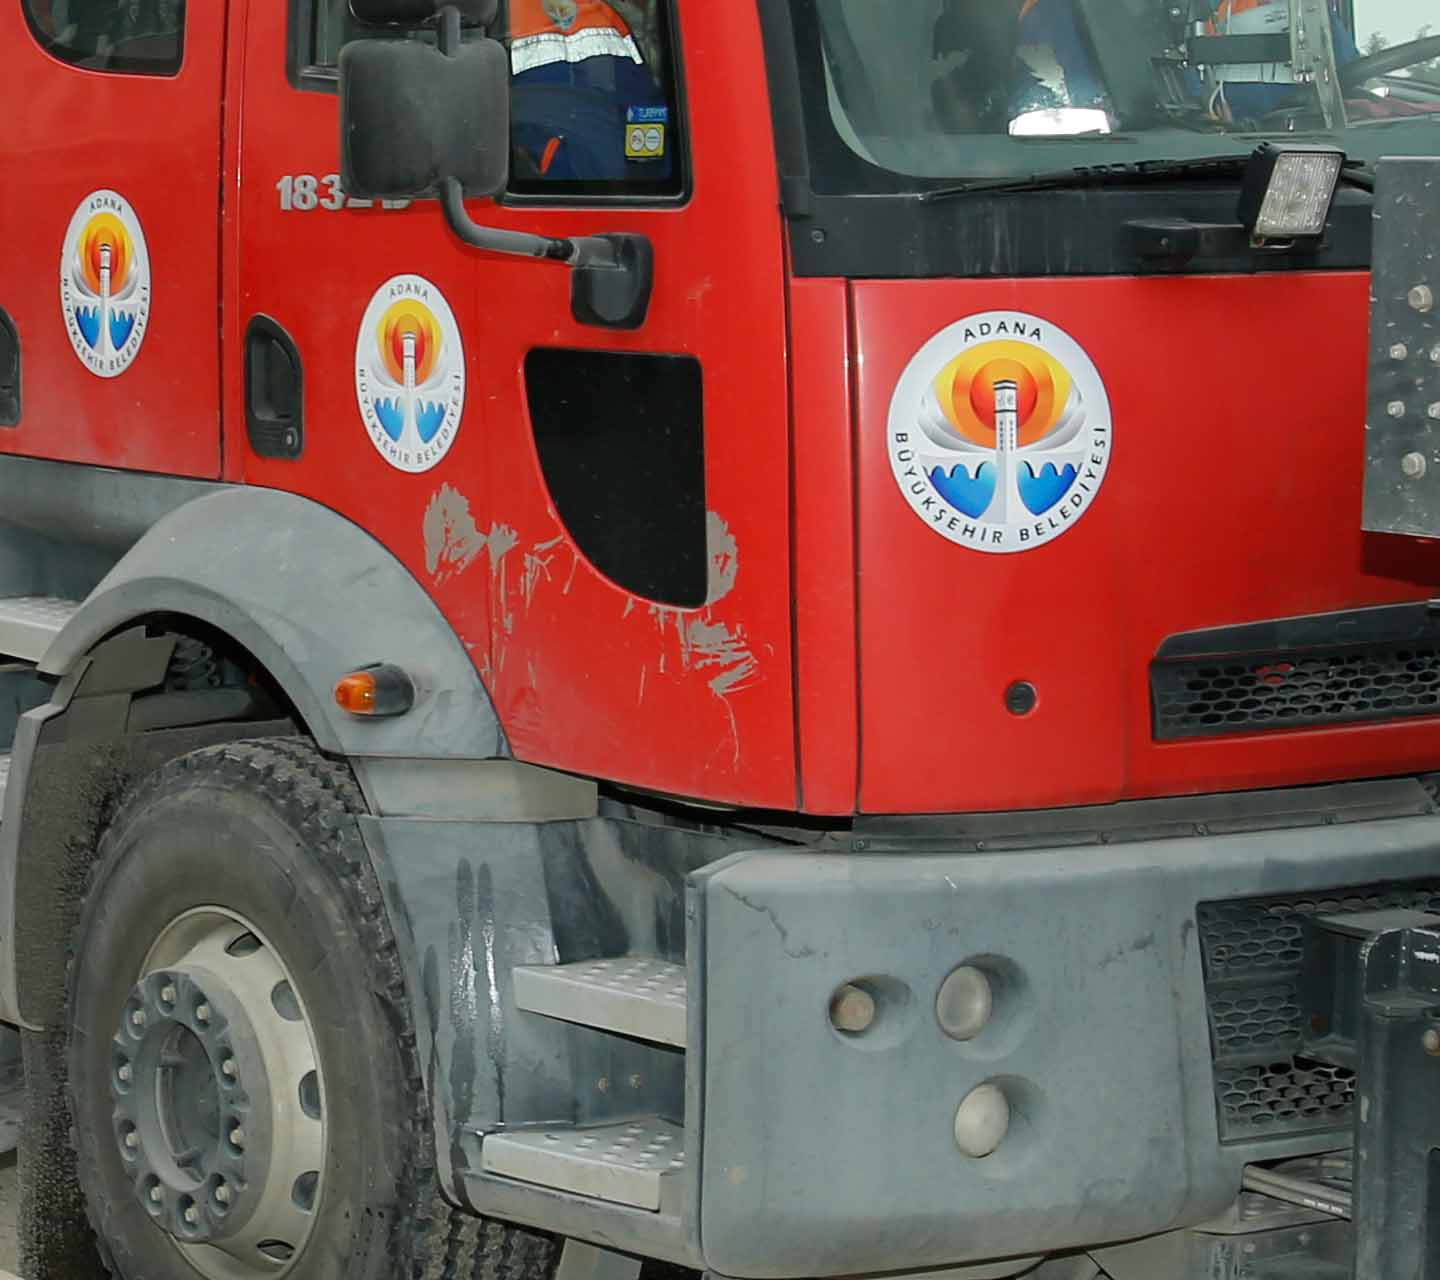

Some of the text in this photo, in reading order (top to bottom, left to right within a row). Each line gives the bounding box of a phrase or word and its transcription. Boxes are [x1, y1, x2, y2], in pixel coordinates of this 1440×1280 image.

[88, 197, 123, 214] ADANA
[388, 283, 430, 299] ADANA
[963, 320, 1043, 342] ADANA
[895, 431, 1004, 544] BÜYÜKŞEHİR
